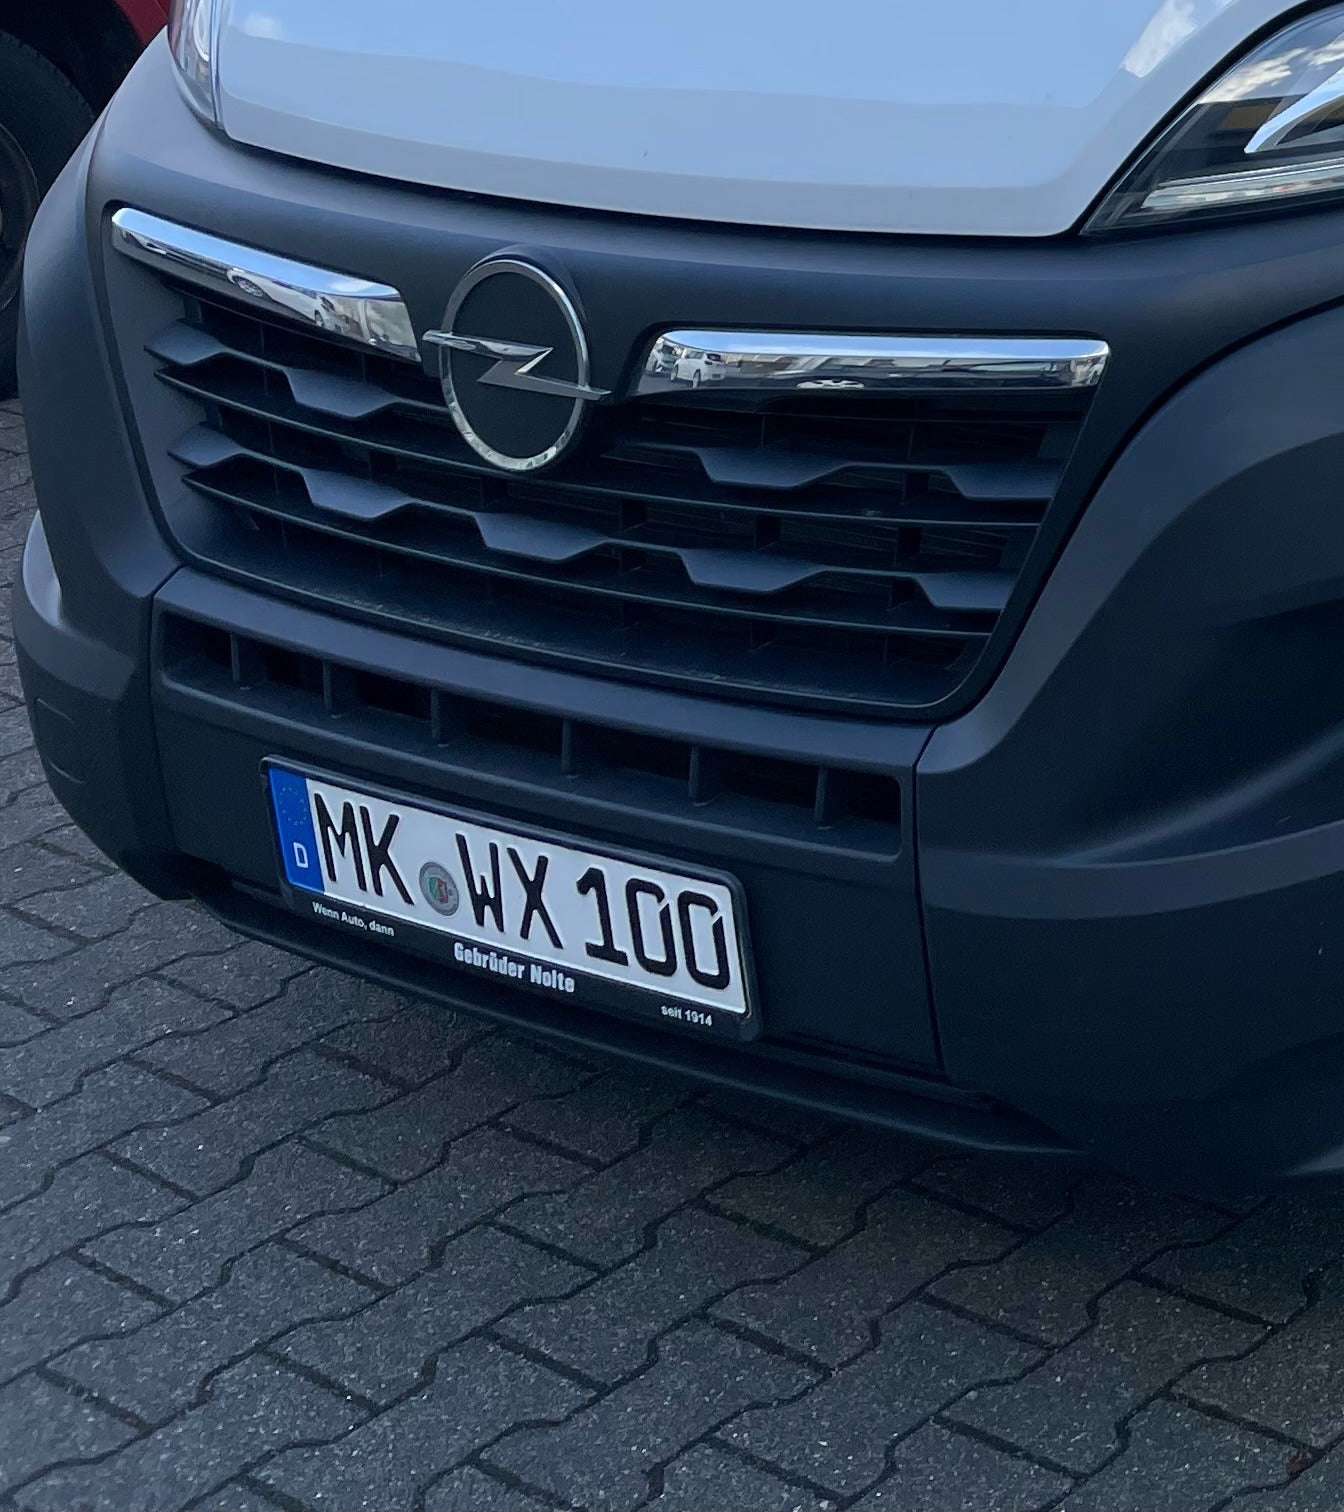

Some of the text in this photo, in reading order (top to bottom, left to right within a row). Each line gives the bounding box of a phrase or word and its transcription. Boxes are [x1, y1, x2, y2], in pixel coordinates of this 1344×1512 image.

[293, 842, 308, 869] D
[314, 792, 731, 991] MK WX 100
[369, 920, 395, 937] dann
[453, 941, 576, 994] Gebrüder Nolte
